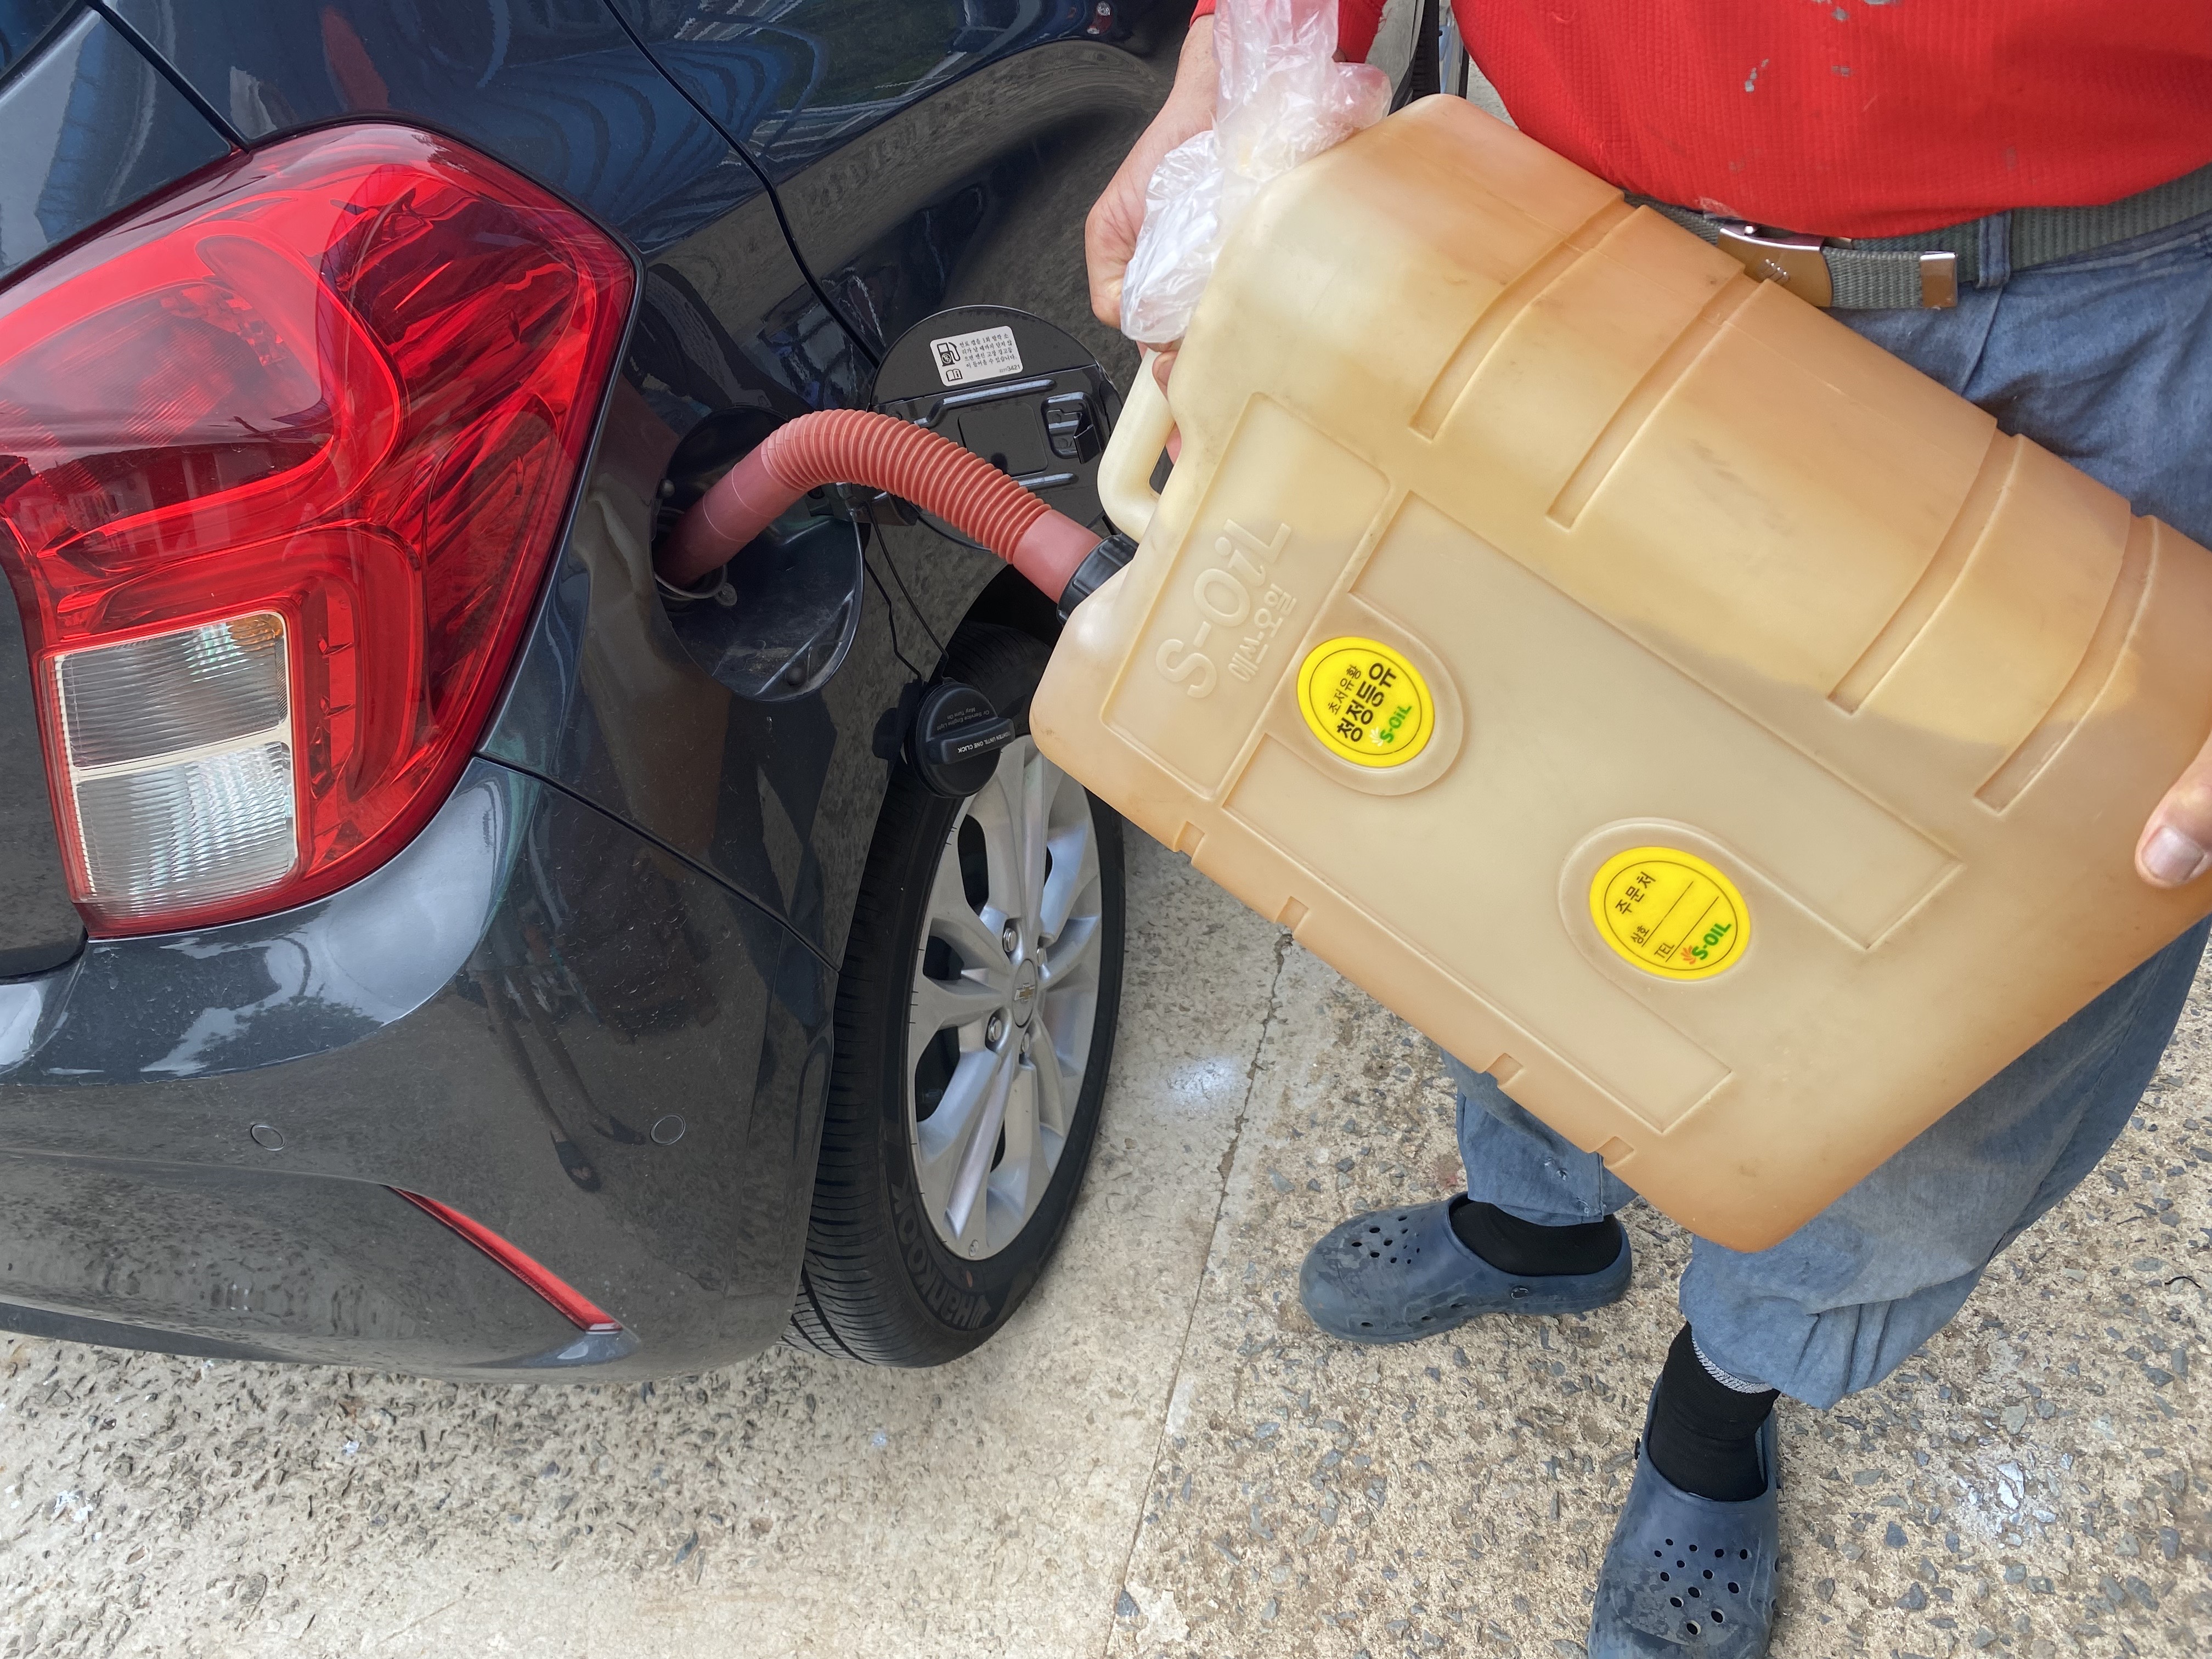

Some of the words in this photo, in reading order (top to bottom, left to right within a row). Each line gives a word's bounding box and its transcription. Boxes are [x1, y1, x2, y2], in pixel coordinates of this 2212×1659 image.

[1228, 583, 1297, 682] 에쓰오일
[1328, 664, 1362, 715] 초저유황
[1336, 662, 1397, 742] 청정등유
[957, 744, 973, 753] CLICK
[984, 736, 996, 744] UNTIL
[1615, 871, 1656, 915] 주문처
[1630, 926, 1650, 944] 상호
[1654, 943, 1675, 958] TEL
[1691, 923, 1733, 960] S-OIL
